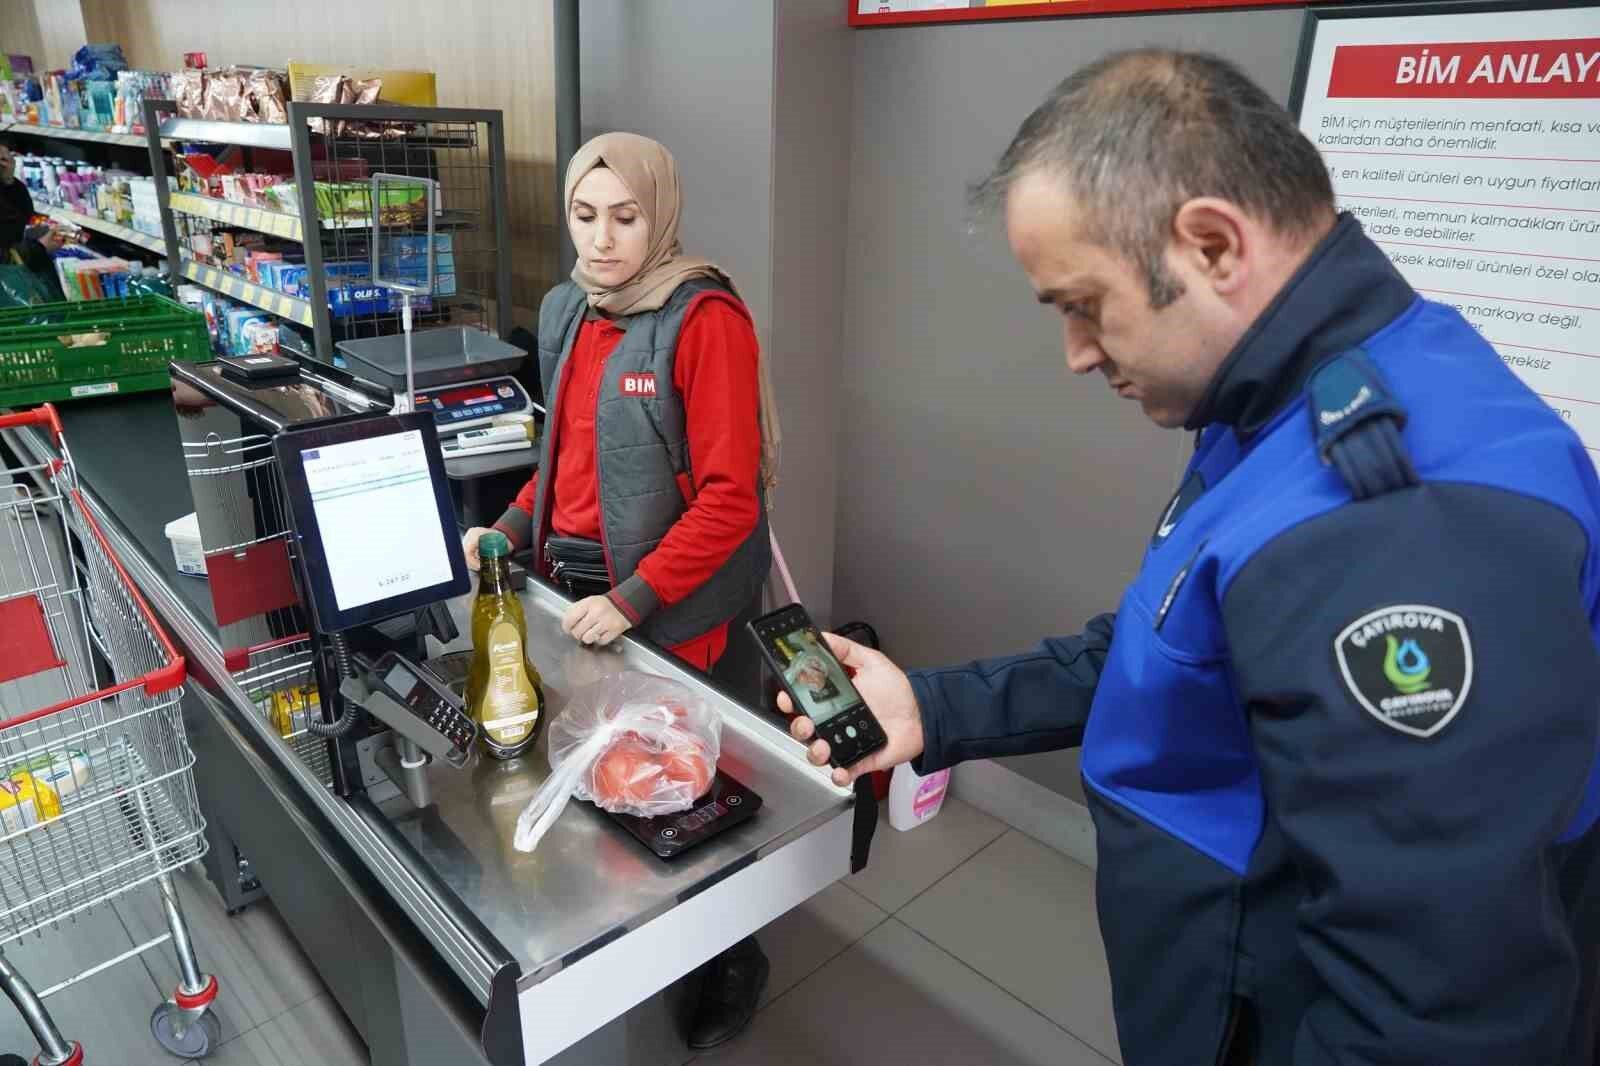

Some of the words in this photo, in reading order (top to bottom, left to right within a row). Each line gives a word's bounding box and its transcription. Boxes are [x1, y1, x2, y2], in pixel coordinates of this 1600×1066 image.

[1395, 49, 1461, 84] BİM
[1321, 116, 1345, 128] BİM
[1347, 117, 1370, 131] için
[1374, 118, 1466, 132] müşterilerinin
[1551, 120, 1582, 133] kısa
[1318, 134, 1380, 146] karlardan
[1385, 136, 1423, 147] daha
[1342, 169, 1359, 179] en
[1362, 169, 1404, 181] kaliteli
[1408, 170, 1459, 184] ürünleri
[1464, 175, 1482, 185] en
[1488, 177, 1536, 190] uygun
[1403, 211, 1466, 223] memnun
[1471, 213, 1565, 231] kalmadıkları
[1428, 255, 1472, 271] kaliteli
[1476, 259, 1531, 277] ürünleri
[1535, 265, 1569, 280] özel
[1467, 303, 1534, 323] markaya
